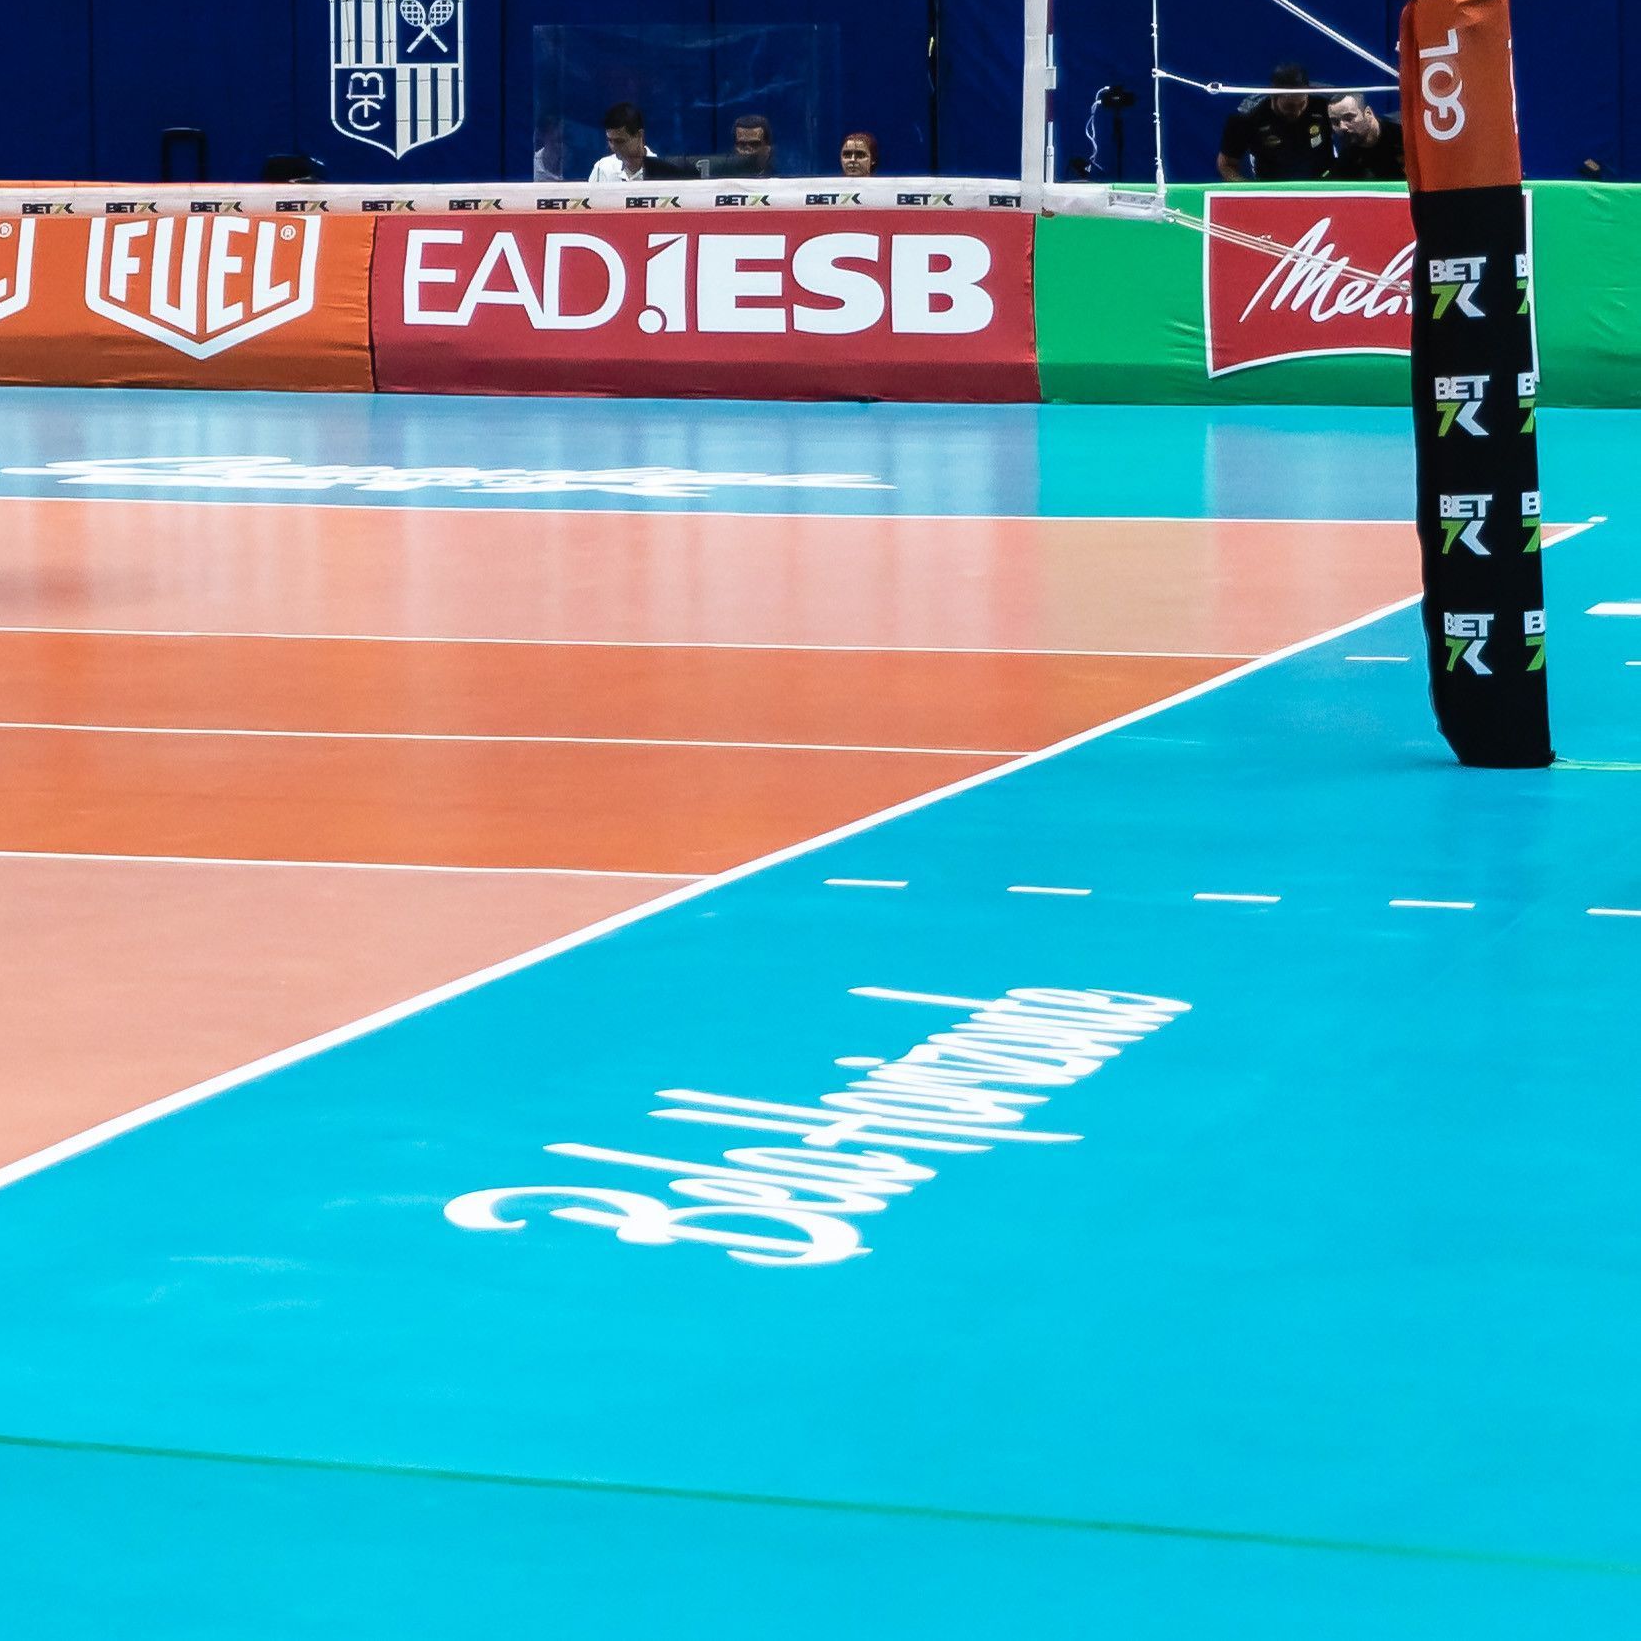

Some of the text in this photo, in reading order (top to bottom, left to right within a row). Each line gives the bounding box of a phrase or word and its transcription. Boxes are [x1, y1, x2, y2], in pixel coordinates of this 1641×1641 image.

[1423, 29, 1467, 142] GOL
[105, 202, 159, 214] BET7K
[275, 200, 330, 213] BET7K
[448, 198, 503, 212] BET7K
[625, 196, 682, 209] BET7K
[805, 193, 861, 206] BET7K
[109, 216, 291, 335] FUEL
[1428, 256, 1487, 284] BET
[1434, 375, 1491, 402] BET
[1439, 493, 1494, 519] BET
[1444, 611, 1495, 639] BET
[444, 986, 1194, 1267] Belo Horizonte
